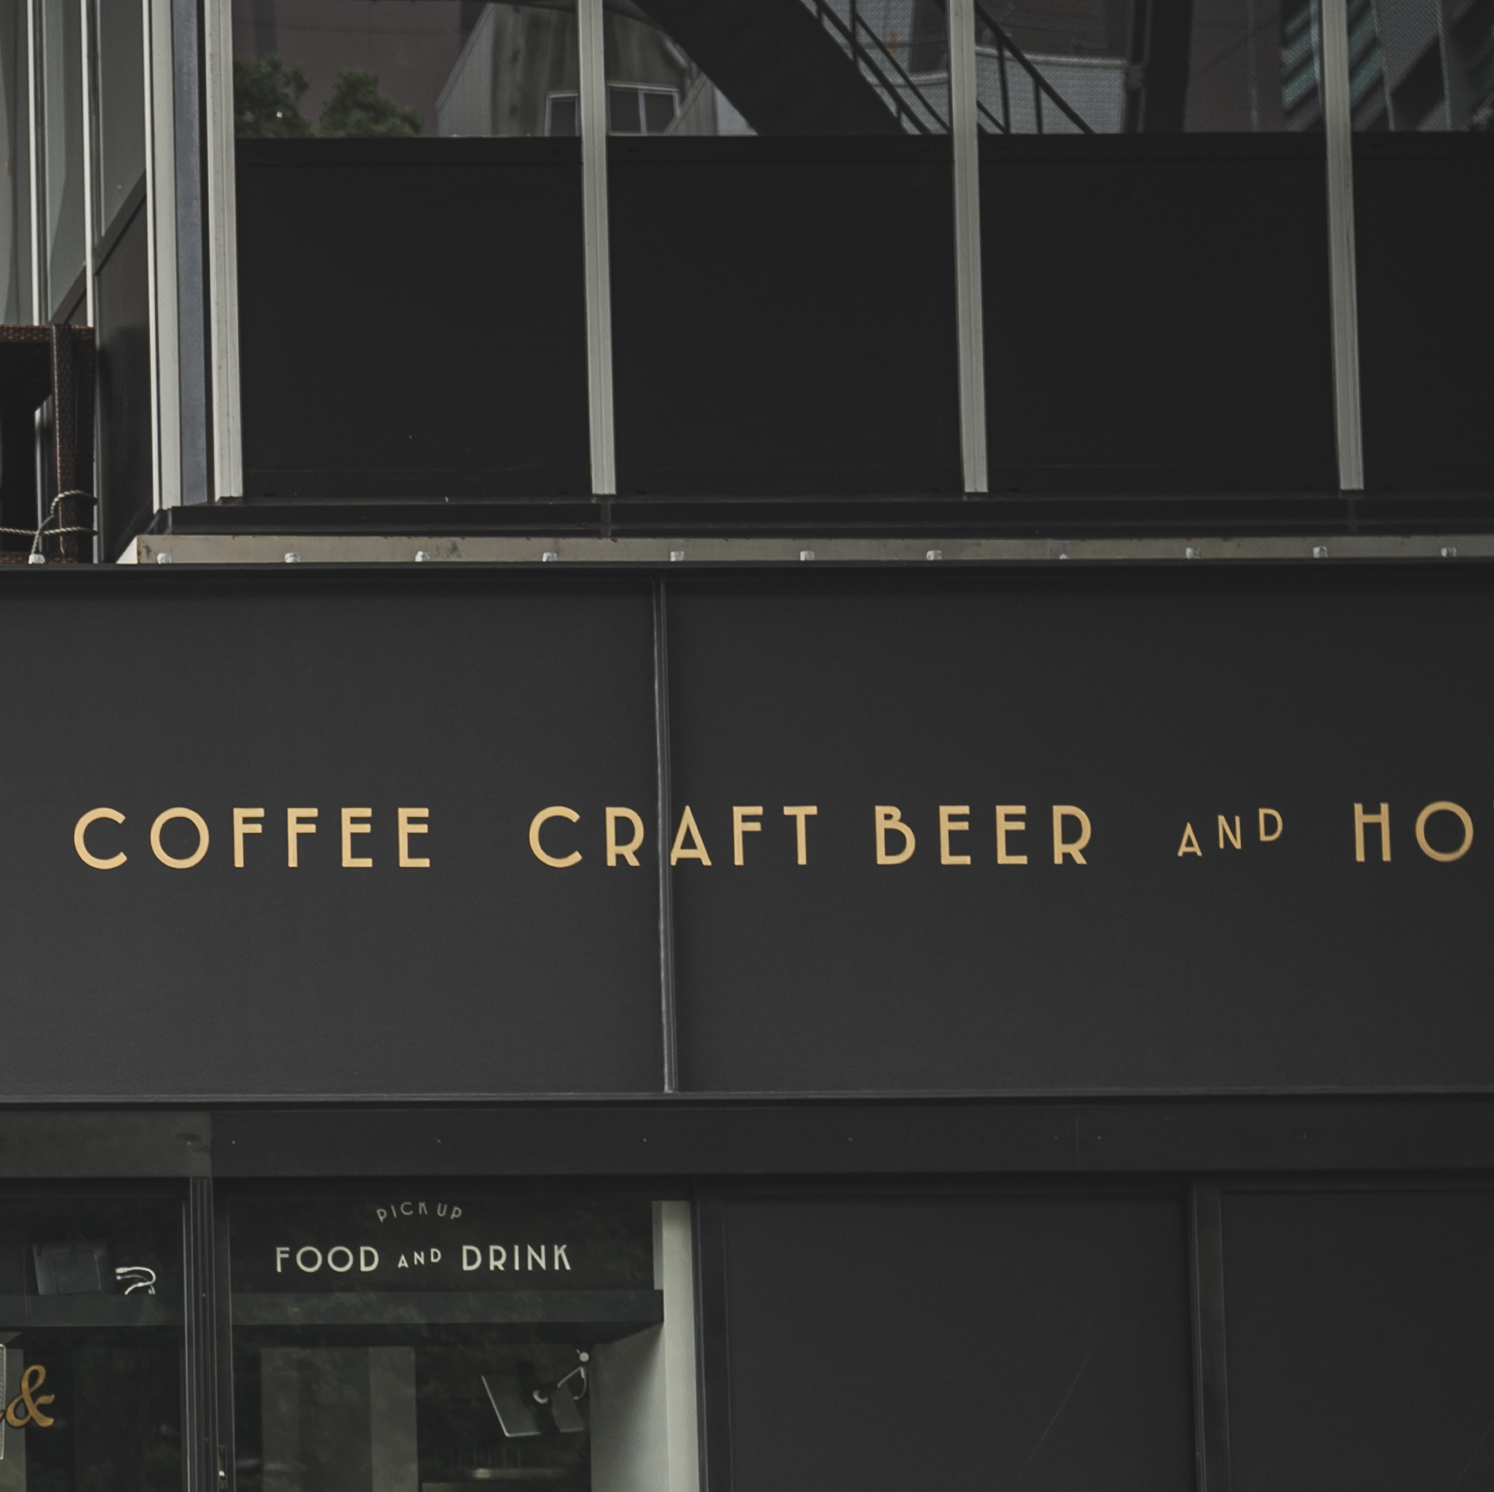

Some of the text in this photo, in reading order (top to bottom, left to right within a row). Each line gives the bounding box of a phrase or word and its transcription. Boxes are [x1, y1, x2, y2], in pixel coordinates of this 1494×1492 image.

[73, 801, 1494, 870] COFFEE CRAFT BEER AND HO
[376, 1202, 463, 1223] PICK UP
[276, 1245, 572, 1272] FOOD AND DRINK
